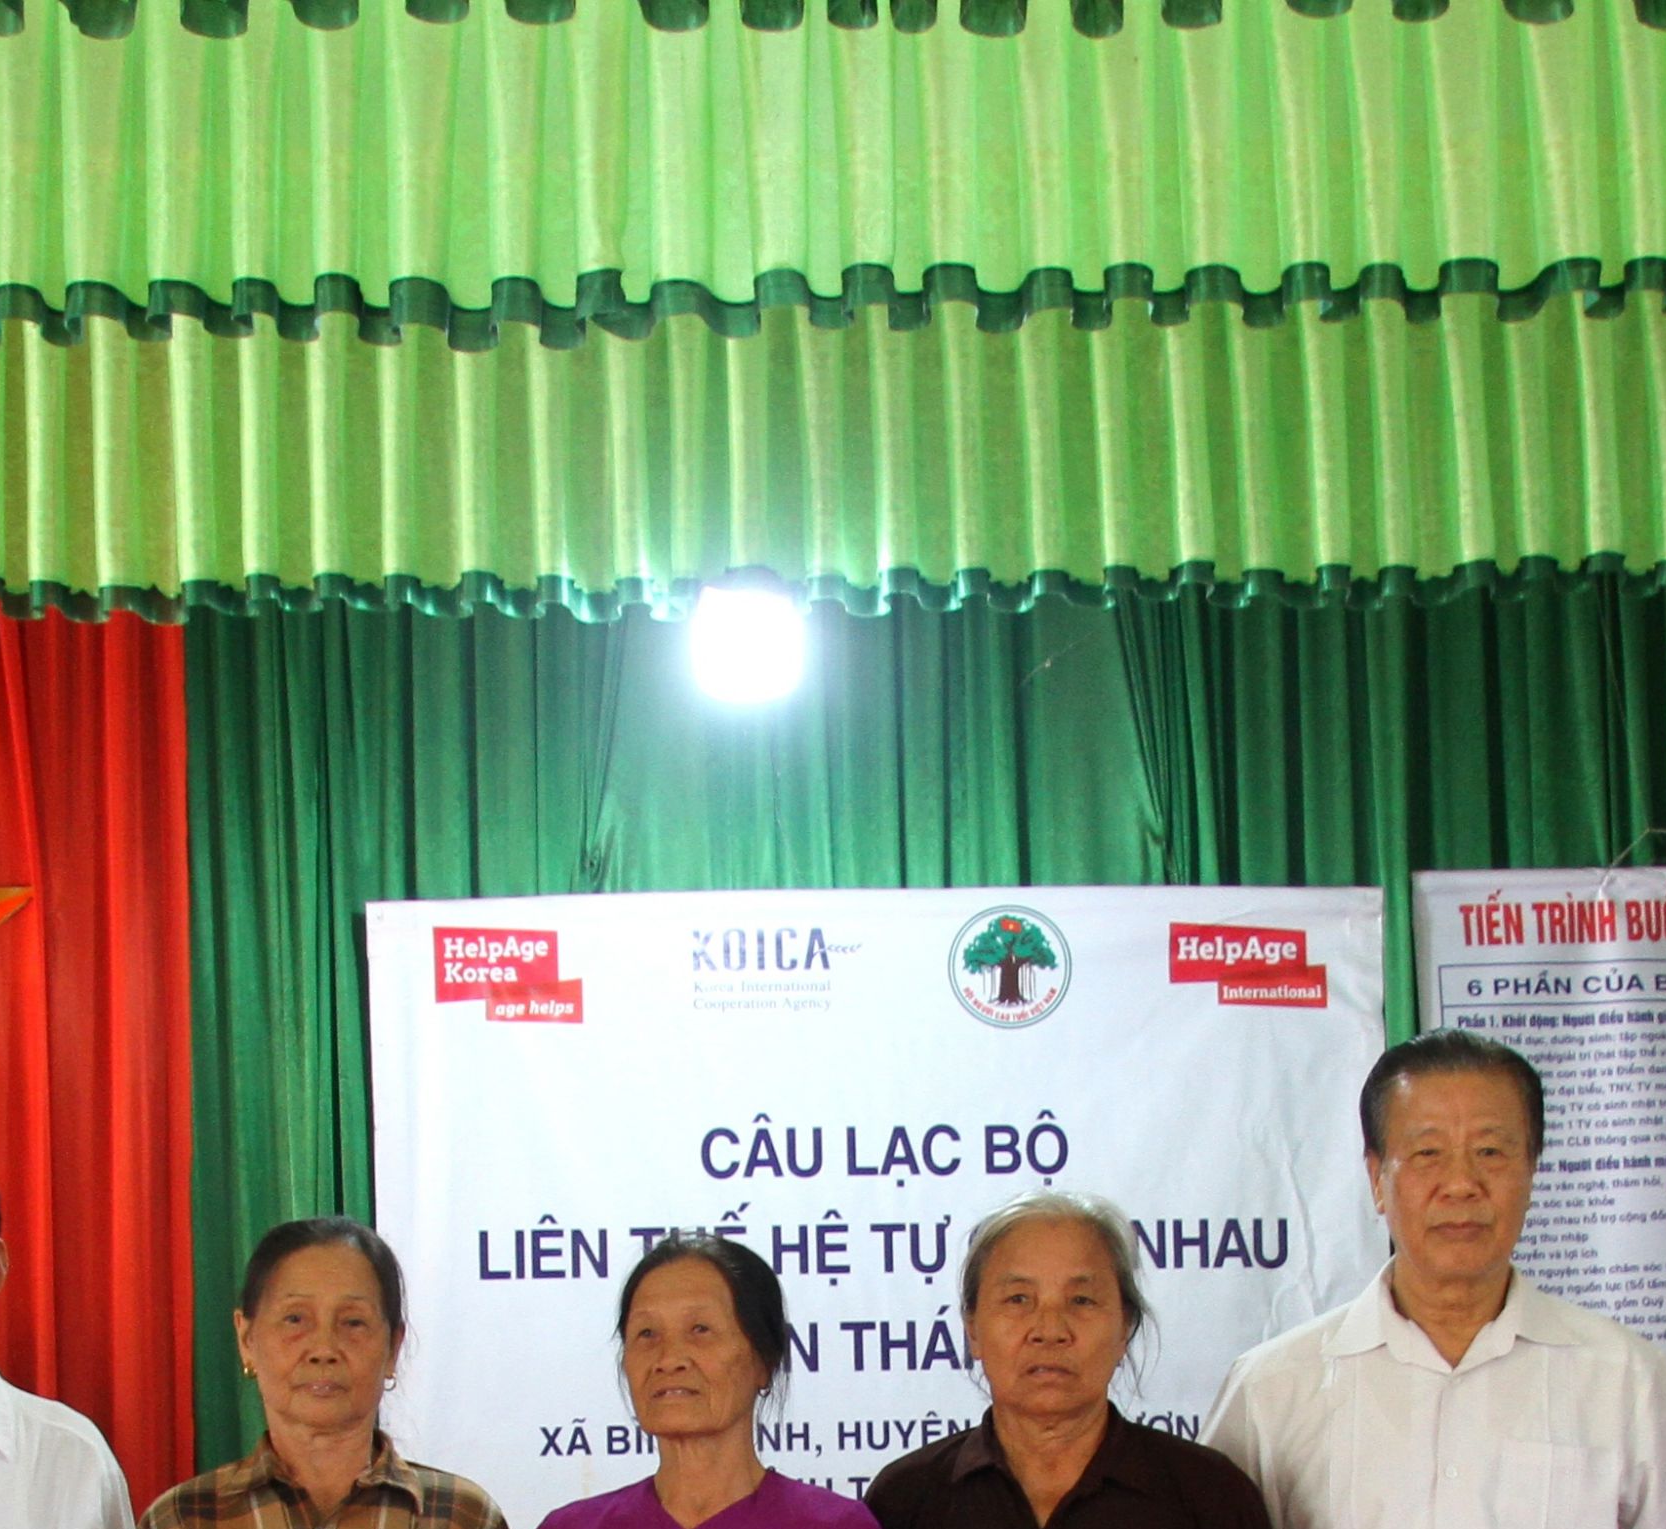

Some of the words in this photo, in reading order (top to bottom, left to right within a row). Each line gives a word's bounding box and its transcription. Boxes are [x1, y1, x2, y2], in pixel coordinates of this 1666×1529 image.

[1459, 889, 1524, 946] TIẾN
[1532, 892, 1618, 944] TRÌNH
[443, 936, 548, 962] HelpAge
[691, 927, 831, 971] KOICA
[1177, 936, 1298, 965] HelpAge
[443, 962, 518, 984] Korea
[693, 981, 734, 994] Korea
[741, 979, 832, 993] International
[1467, 980, 1482, 996] 6
[1493, 969, 1572, 995] PHẦN
[1583, 967, 1645, 994] CỦA
[693, 998, 778, 1013] Cooperation
[782, 997, 832, 1013] Agency
[1222, 984, 1322, 1000] International
[495, 1002, 525, 1018] age
[529, 999, 575, 1018] helps
[700, 1113, 823, 1180] CÂU
[846, 1124, 961, 1188] LẠC
[984, 1109, 1069, 1187] BỘ
[479, 1214, 609, 1281] LIÊN
[771, 1209, 851, 1286] HỆ
[870, 1214, 952, 1285] TỰ
[1130, 1217, 1289, 1269] NHAU
[540, 1418, 592, 1457] XÃ
